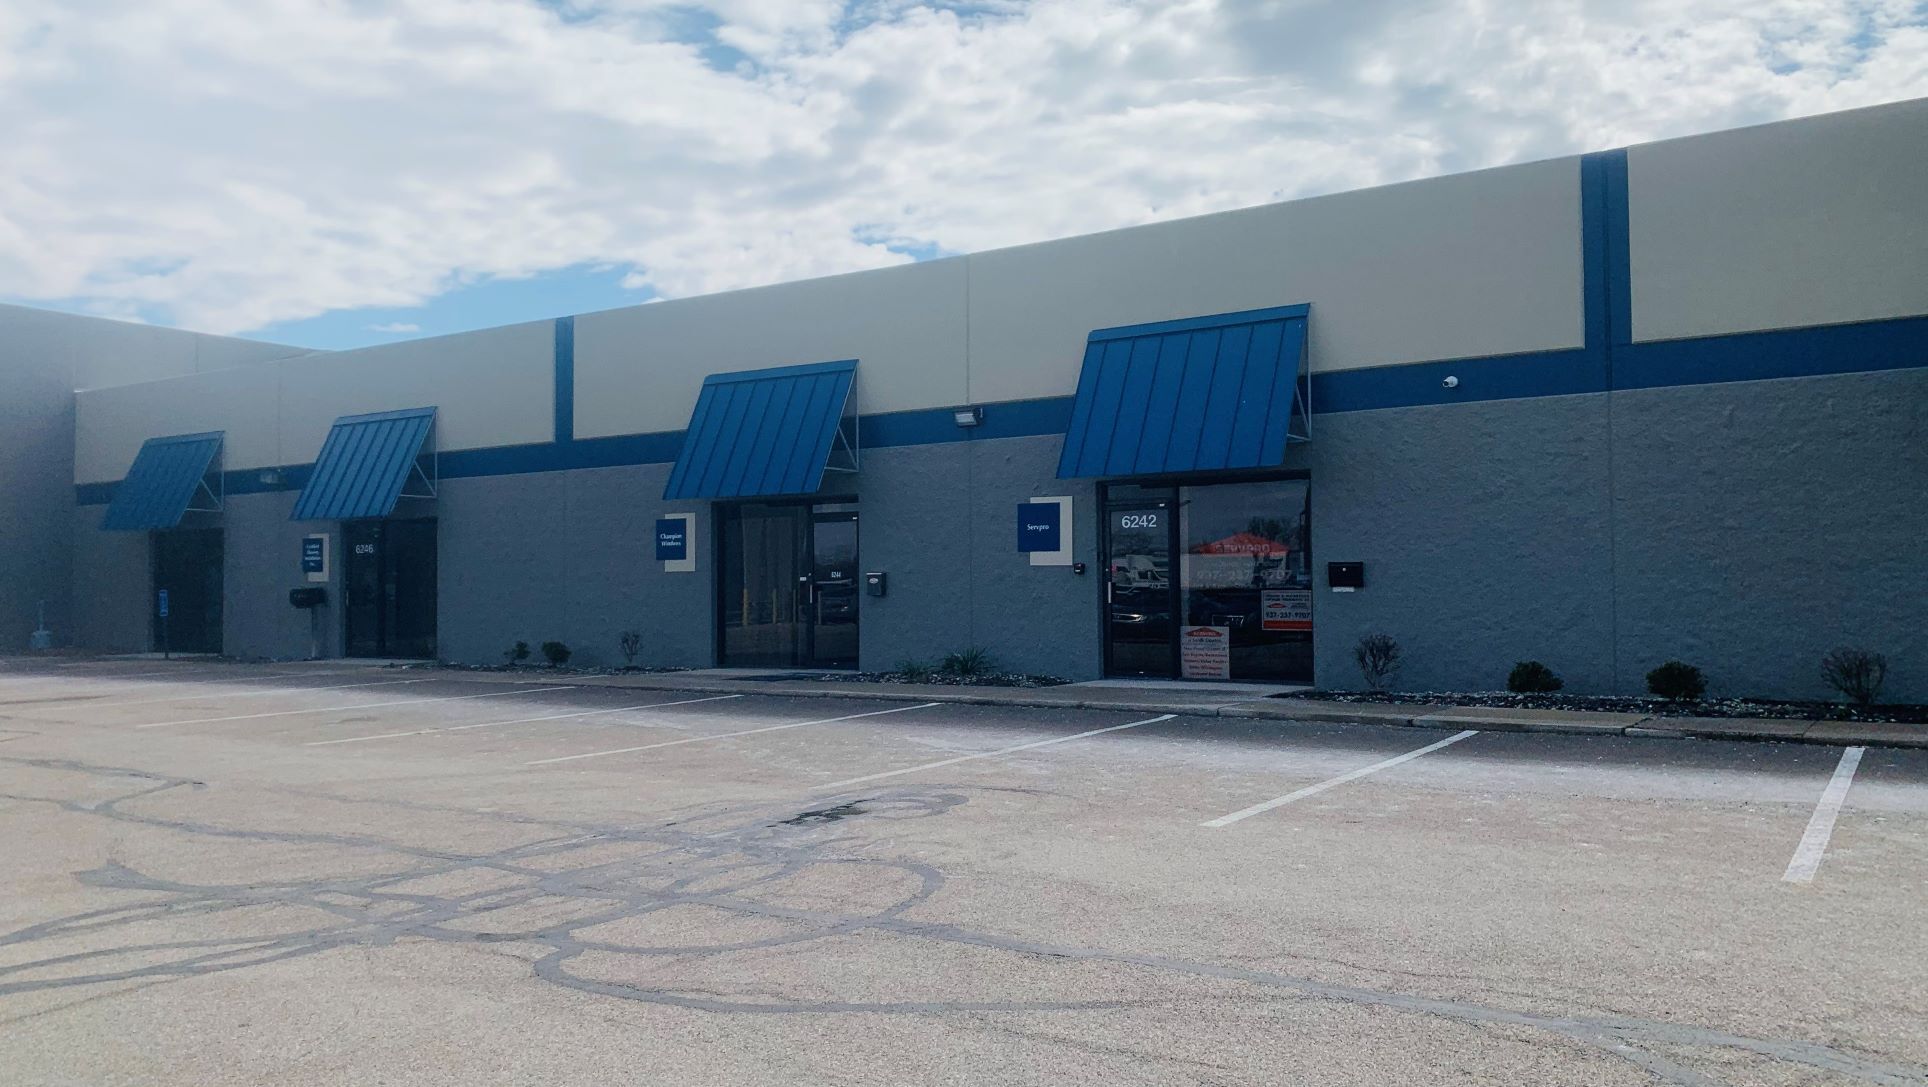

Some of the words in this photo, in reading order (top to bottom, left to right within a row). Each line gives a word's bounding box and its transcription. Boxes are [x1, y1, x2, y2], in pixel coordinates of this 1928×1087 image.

[1121, 514, 1157, 529] 6242
[1027, 523, 1050, 532] Servpro
[355, 544, 374, 554] 6246
